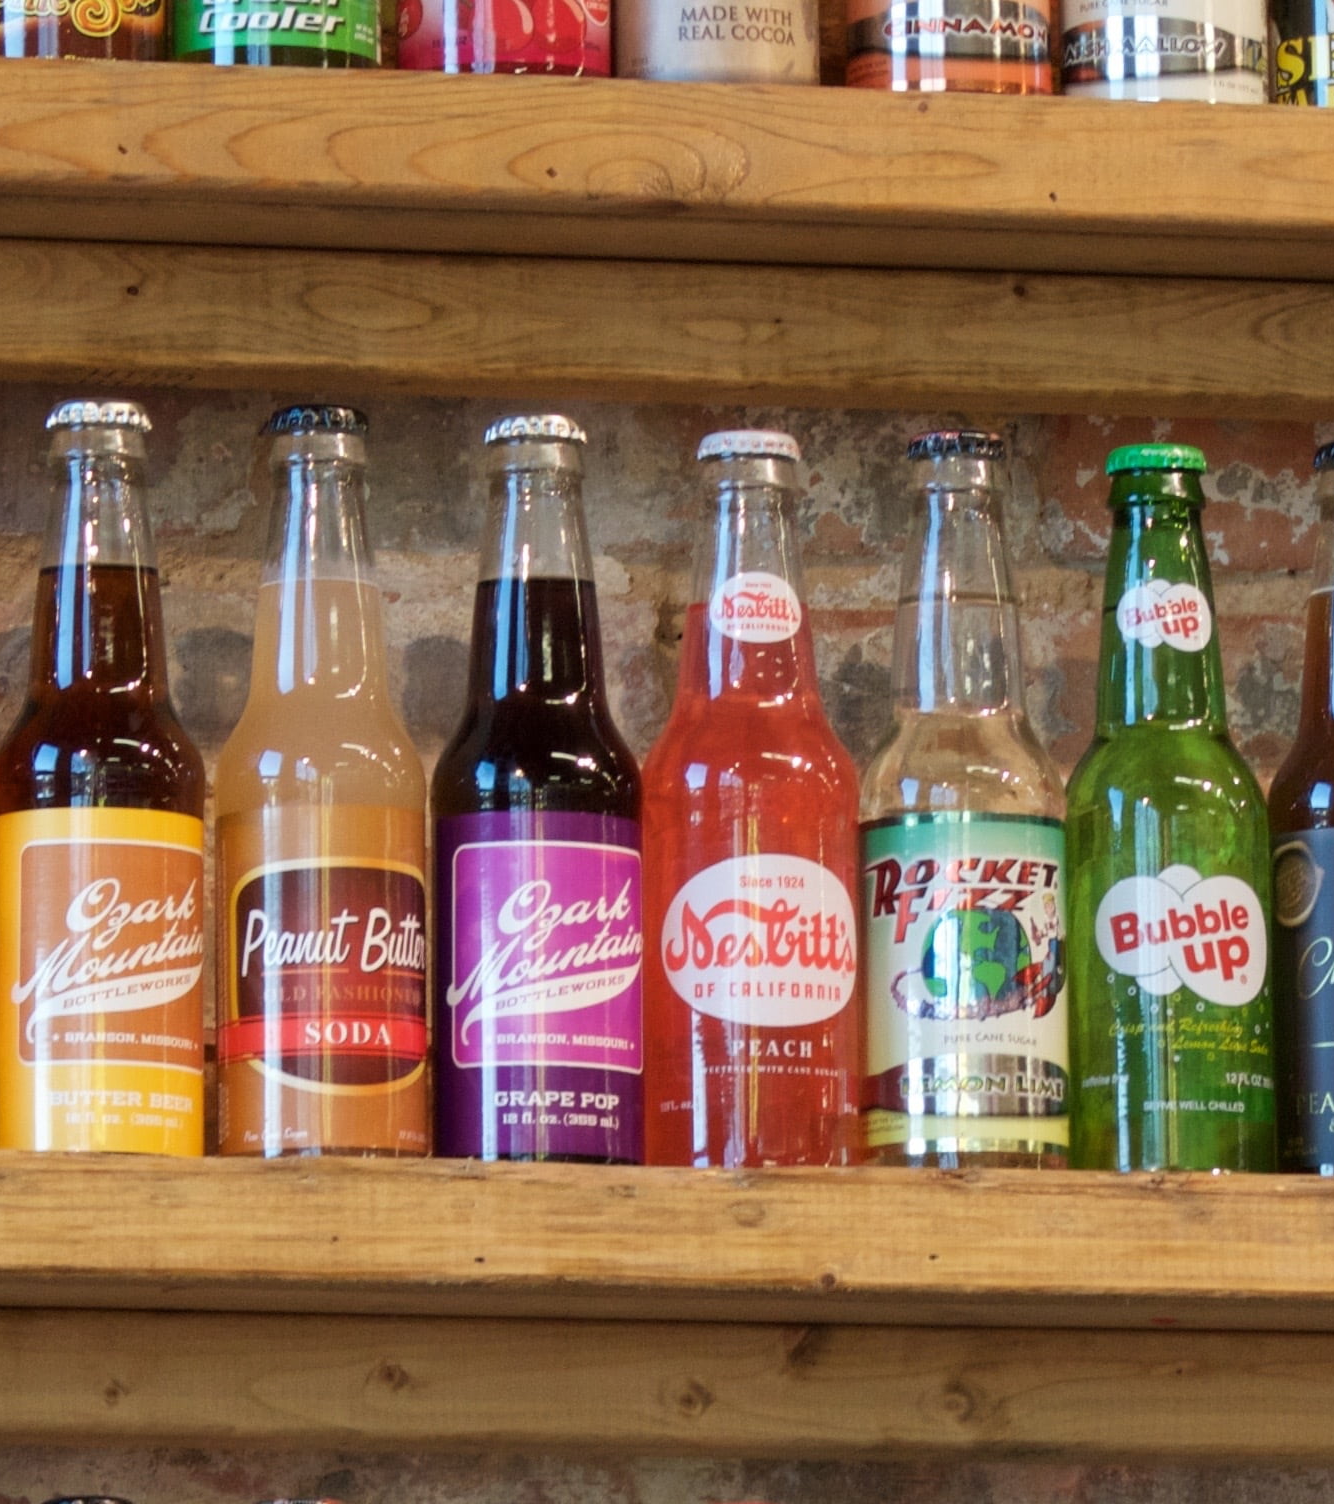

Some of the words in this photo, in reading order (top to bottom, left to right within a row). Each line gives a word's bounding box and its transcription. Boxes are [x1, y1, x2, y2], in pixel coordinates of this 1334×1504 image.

[198, 8, 346, 36] Cooler
[242, 908, 351, 977] Peanut
[498, 880, 631, 956] Ozark
[665, 900, 857, 976] Nesbitt's
[1109, 902, 1249, 955] Bubble
[447, 930, 643, 1009] Mountain
[568, 1036, 628, 1049] MISSOURI
[732, 1041, 814, 1060] PEACH
[493, 1089, 579, 1109] GRAPE
[583, 1093, 620, 1111] POP
